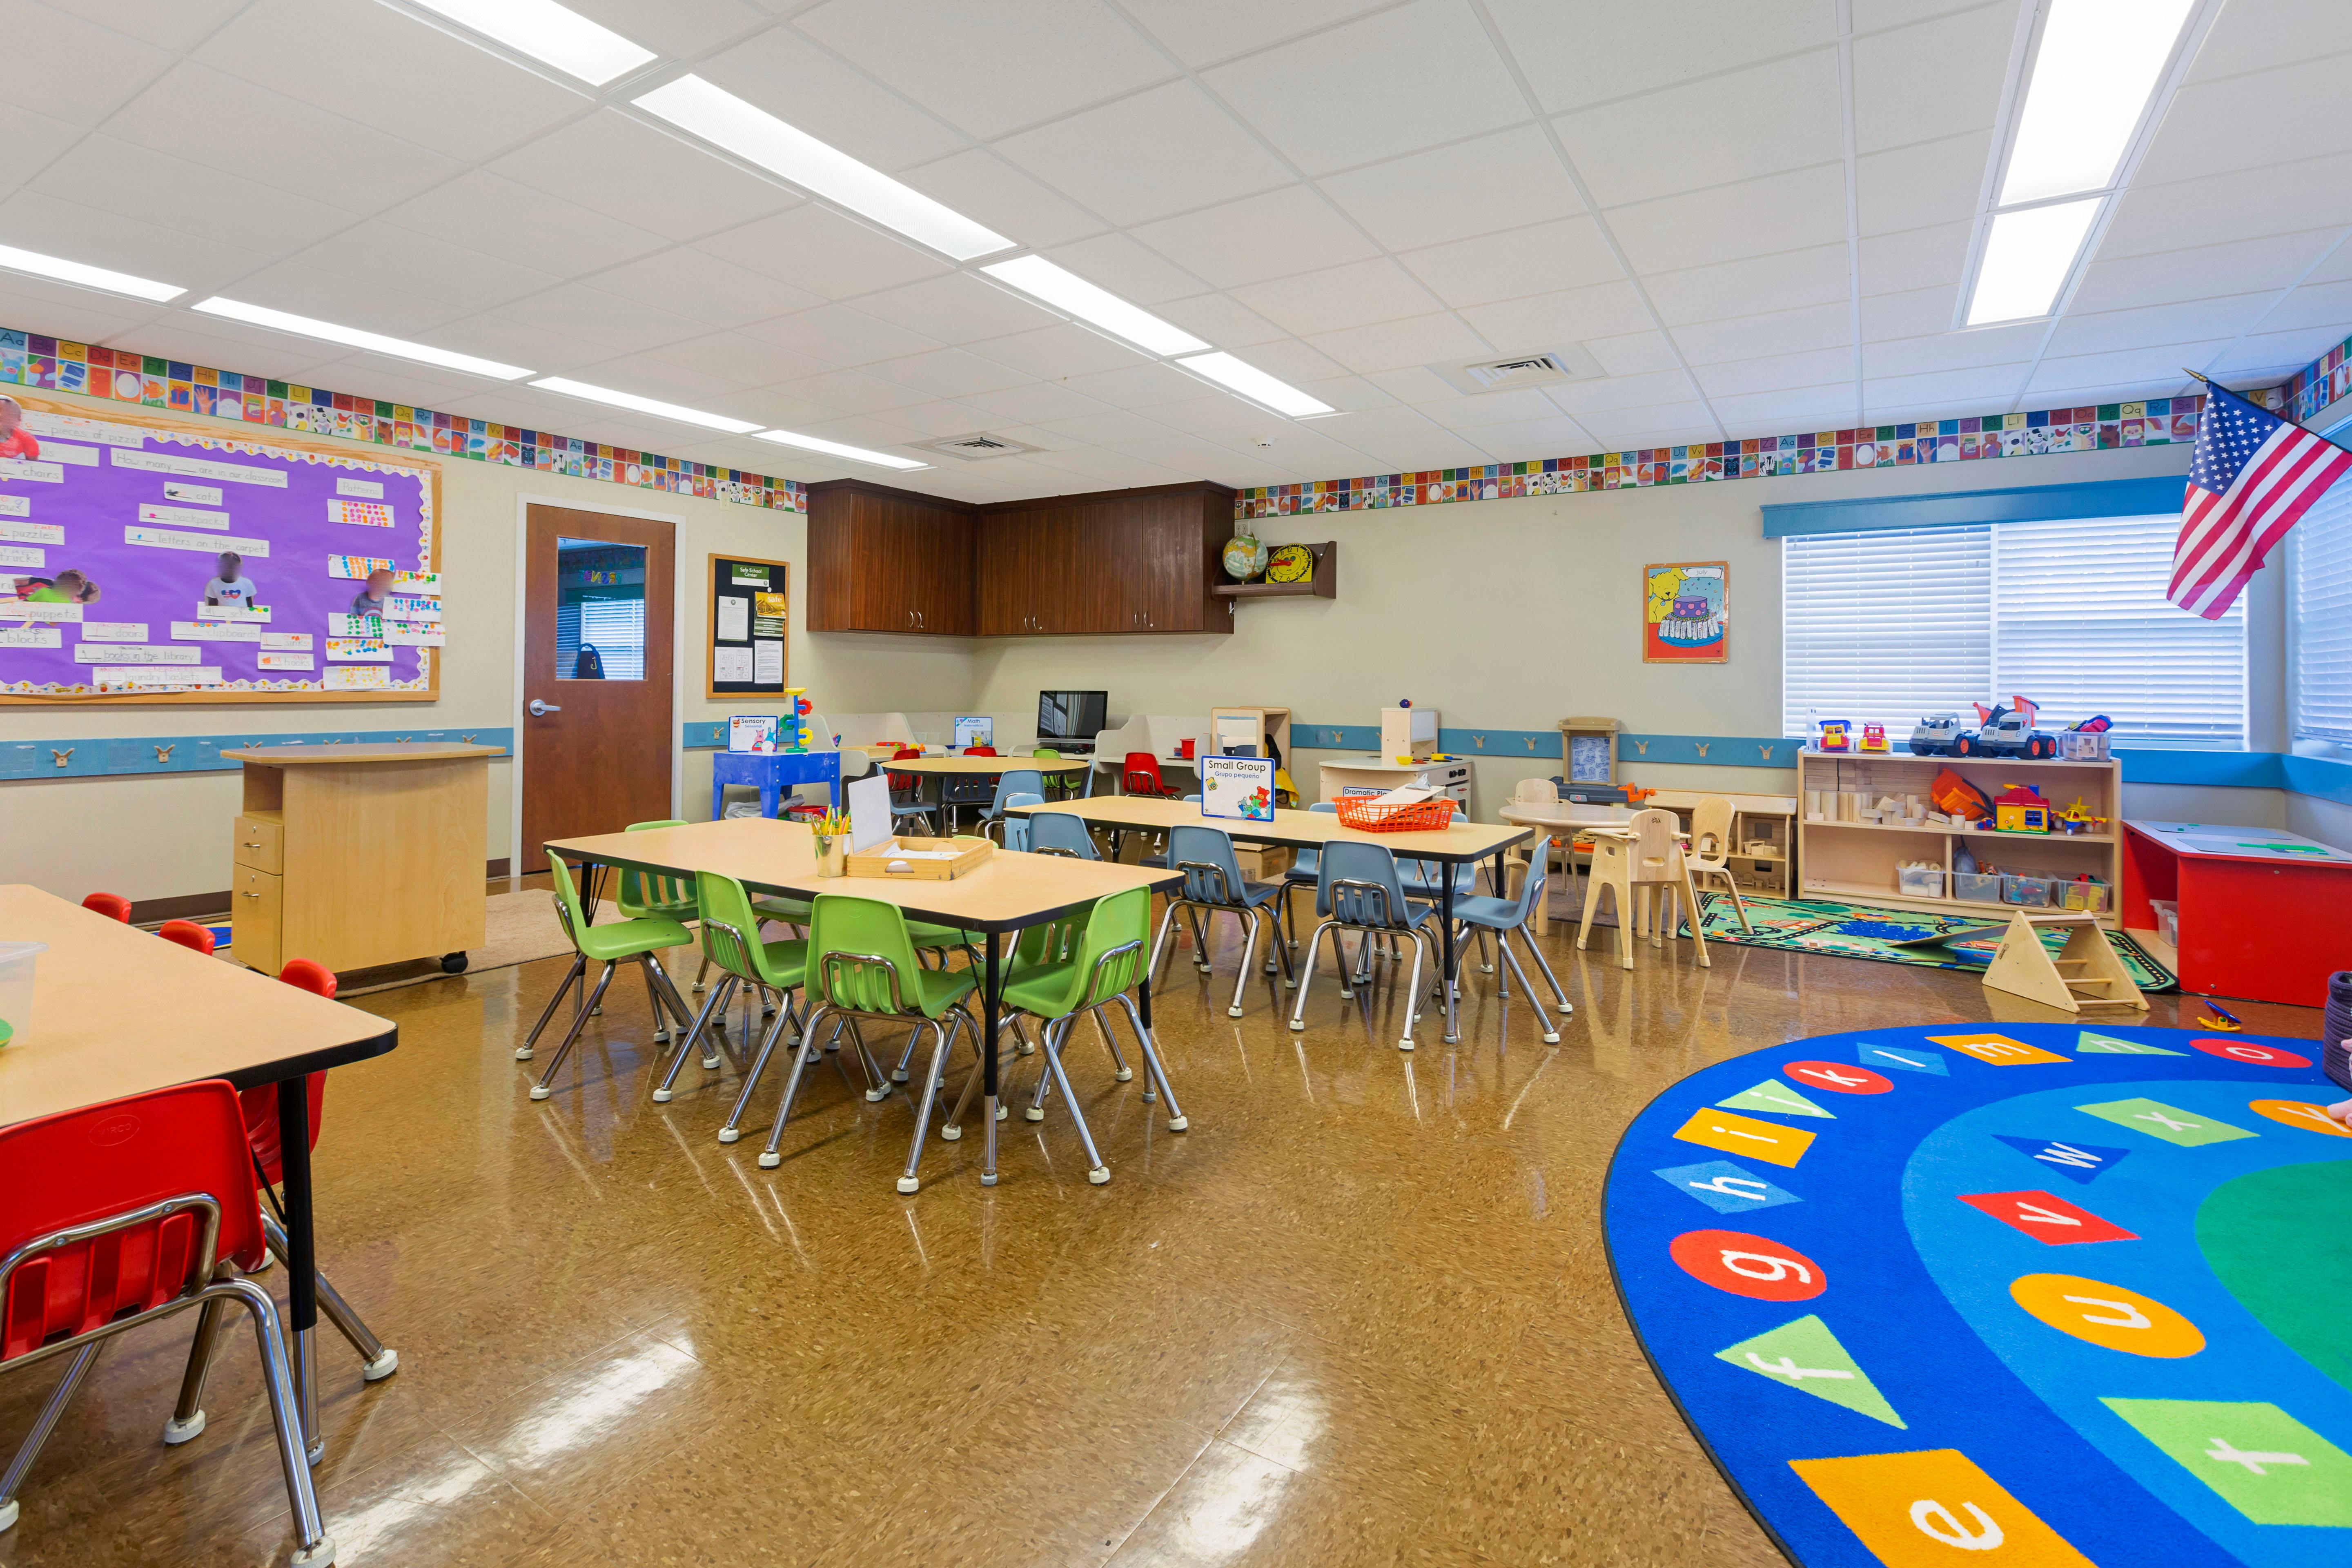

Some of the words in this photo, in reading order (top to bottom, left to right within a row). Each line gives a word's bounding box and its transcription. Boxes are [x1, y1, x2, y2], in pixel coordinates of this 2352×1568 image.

[0, 332, 24, 346] Aa
[62, 344, 82, 356] Cc
[90, 349, 109, 361] Dd
[120, 354, 137, 367] Ee
[171, 364, 190, 377] Gg
[197, 369, 214, 380] Hh
[227, 374, 234, 385] Ii
[247, 379, 261, 393] Jj
[270, 384, 284, 394] Kk
[294, 388, 304, 398] Ll
[336, 396, 350, 406] Nn
[356, 400, 371, 410] Oo
[377, 404, 390, 416] Pp
[395, 408, 412, 422] Qq
[416, 411, 430, 421] Rr
[437, 414, 447, 425] Ss
[456, 418, 465, 428] Tt
[472, 421, 484, 432] Uu
[490, 425, 500, 434] Vv
[505, 427, 519, 437] Ww
[540, 435, 549, 447] Yy
[555, 437, 565, 447] Zz
[51, 428, 86, 438] pieces
[93, 430, 103, 439] of
[109, 432, 138, 444] pizza
[1457, 470, 1468, 479] Gg
[1500, 466, 1510, 475] Jj
[1591, 457, 1602, 466] Pp
[1606, 456, 1619, 465] Qq
[1745, 442, 1756, 452] Yy
[1762, 440, 1774, 448] Zz
[1780, 438, 1795, 446] Aa
[1838, 432, 1852, 440] Dd
[1859, 430, 1872, 439] Ee
[1879, 428, 1891, 436] Ff
[1898, 426, 1913, 438] Gg
[1920, 424, 1934, 432] Hh
[1945, 421, 1951, 430] Ii
[1963, 420, 1976, 432] Jj
[1985, 418, 1999, 427] Kk
[2008, 416, 2019, 425] Ll
[2052, 412, 2069, 421] Nn
[2075, 410, 2093, 419] Oo
[2100, 408, 2116, 419] Pp
[2122, 405, 2144, 417] Qq
[2149, 402, 2165, 412] Rr
[2176, 400, 2191, 409] Ss
[117, 453, 139, 465] How
[146, 461, 171, 471] many
[23, 466, 59, 479] chairs
[343, 482, 379, 495] Patterns
[196, 493, 219, 502] cats
[174, 513, 225, 526] backpacks
[12, 530, 55, 540] puzzles
[159, 534, 190, 546] letters
[214, 539, 230, 550] the
[236, 543, 265, 554] carpet
[30, 609, 77, 619] puppets
[7, 633, 47, 644] blocks
[116, 629, 144, 637] doors
[206, 629, 258, 639] clipboards
[104, 650, 130, 659] books
[164, 651, 194, 663] library
[285, 657, 310, 666] hooks
[126, 673, 160, 682] laundry
[1209, 760, 1233, 769] Small
[1236, 762, 1266, 773] Group
[1962, 1043, 2031, 1057] m
[2090, 1040, 2144, 1052] n
[2226, 1047, 2274, 1059] o
[1873, 1050, 1926, 1067] l
[1799, 1069, 1868, 1086] k
[1749, 1092, 1823, 1115] j
[2133, 1111, 2201, 1131] x
[1712, 1126, 1778, 1143] i
[2034, 1142, 2102, 1168] w
[1689, 1176, 1767, 1200] h
[2016, 1202, 2082, 1225] v
[1720, 1250, 1811, 1284] g
[2062, 1295, 2152, 1328] u
[1745, 1353, 1855, 1380] f
[2205, 1438, 2310, 1474] t
[1909, 1499, 2004, 1550] e
